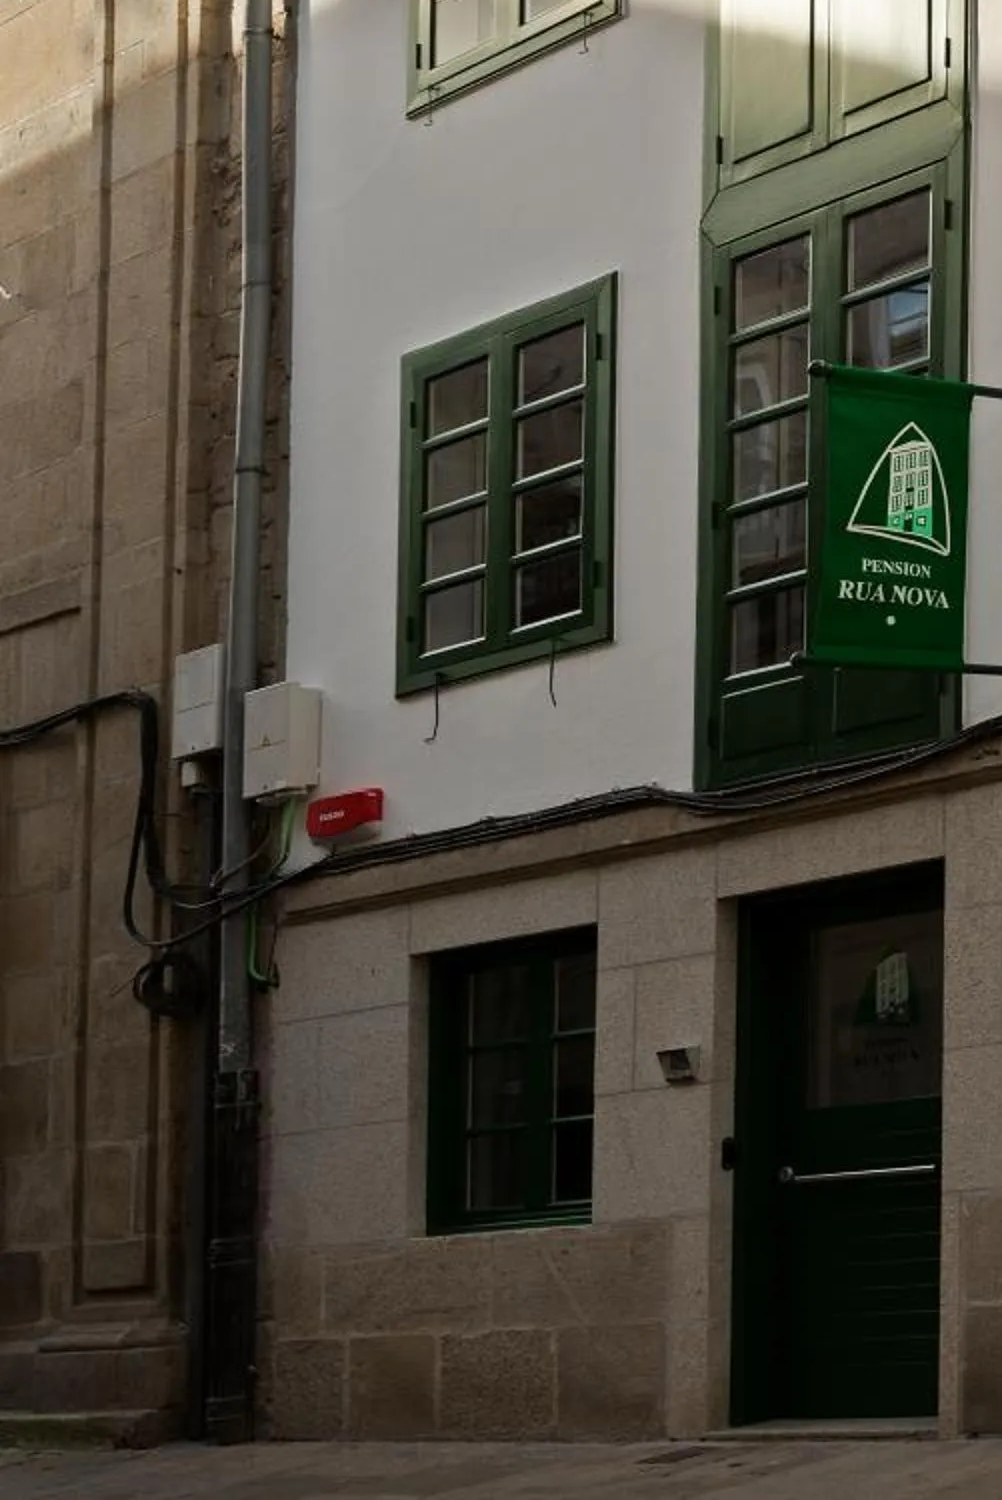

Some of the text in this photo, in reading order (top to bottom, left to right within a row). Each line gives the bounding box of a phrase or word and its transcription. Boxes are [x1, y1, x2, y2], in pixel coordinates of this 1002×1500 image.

[861, 557, 932, 578] PENSION
[837, 579, 949, 609] RUA NOVA
